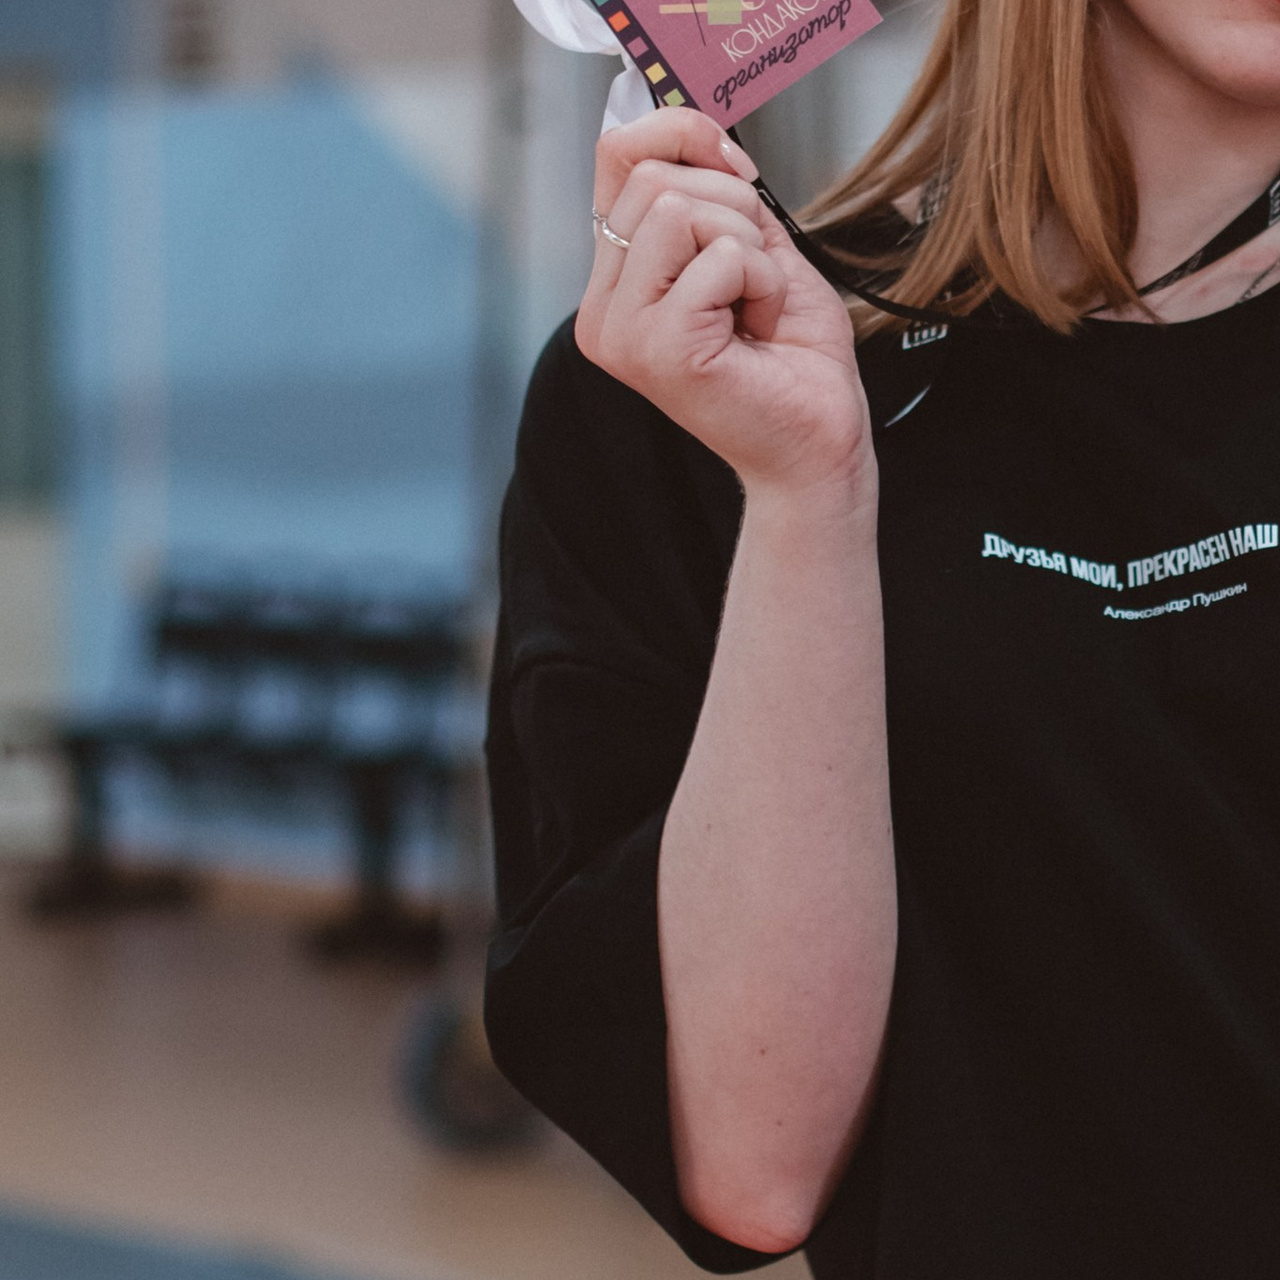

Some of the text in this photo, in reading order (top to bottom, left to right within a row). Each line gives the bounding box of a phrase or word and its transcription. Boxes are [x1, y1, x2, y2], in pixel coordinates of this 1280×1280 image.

[981, 533, 1067, 573] ДРУЗЬЯ
[1070, 556, 1123, 591] МОИ,
[1127, 533, 1231, 587] ПРЕКРАСЕН
[1228, 524, 1279, 558] НАШ
[1103, 582, 1248, 620] Александр Пушкин
